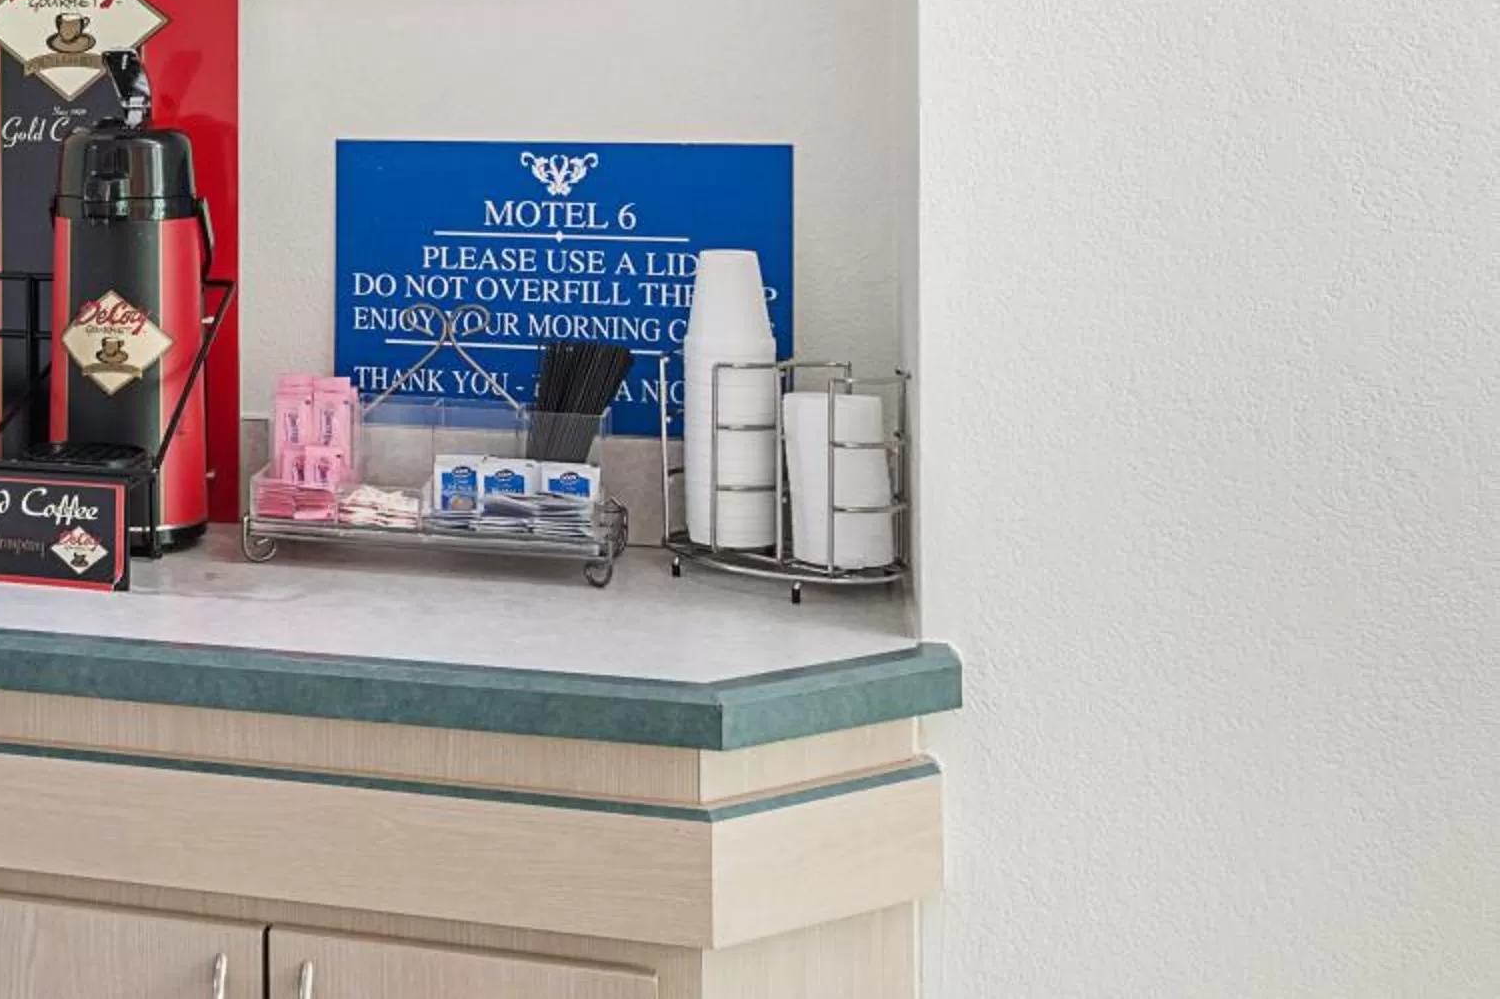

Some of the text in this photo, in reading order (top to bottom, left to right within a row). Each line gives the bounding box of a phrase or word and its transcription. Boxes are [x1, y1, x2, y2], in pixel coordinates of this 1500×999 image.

[1, 115, 47, 149] Gold
[483, 199, 637, 230] MOTEL 6
[422, 244, 700, 278] PLEASE USE A LID
[352, 271, 397, 297] DO
[404, 273, 469, 301] NOT
[475, 276, 631, 307] OVERFILL
[353, 306, 436, 333] ENJOY
[444, 309, 520, 337] YOUR
[528, 312, 661, 343] MORNING
[353, 365, 444, 393] THANK
[452, 369, 509, 396] YOU
[614, 379, 634, 403] A
[21, 486, 99, 526] Coffee
